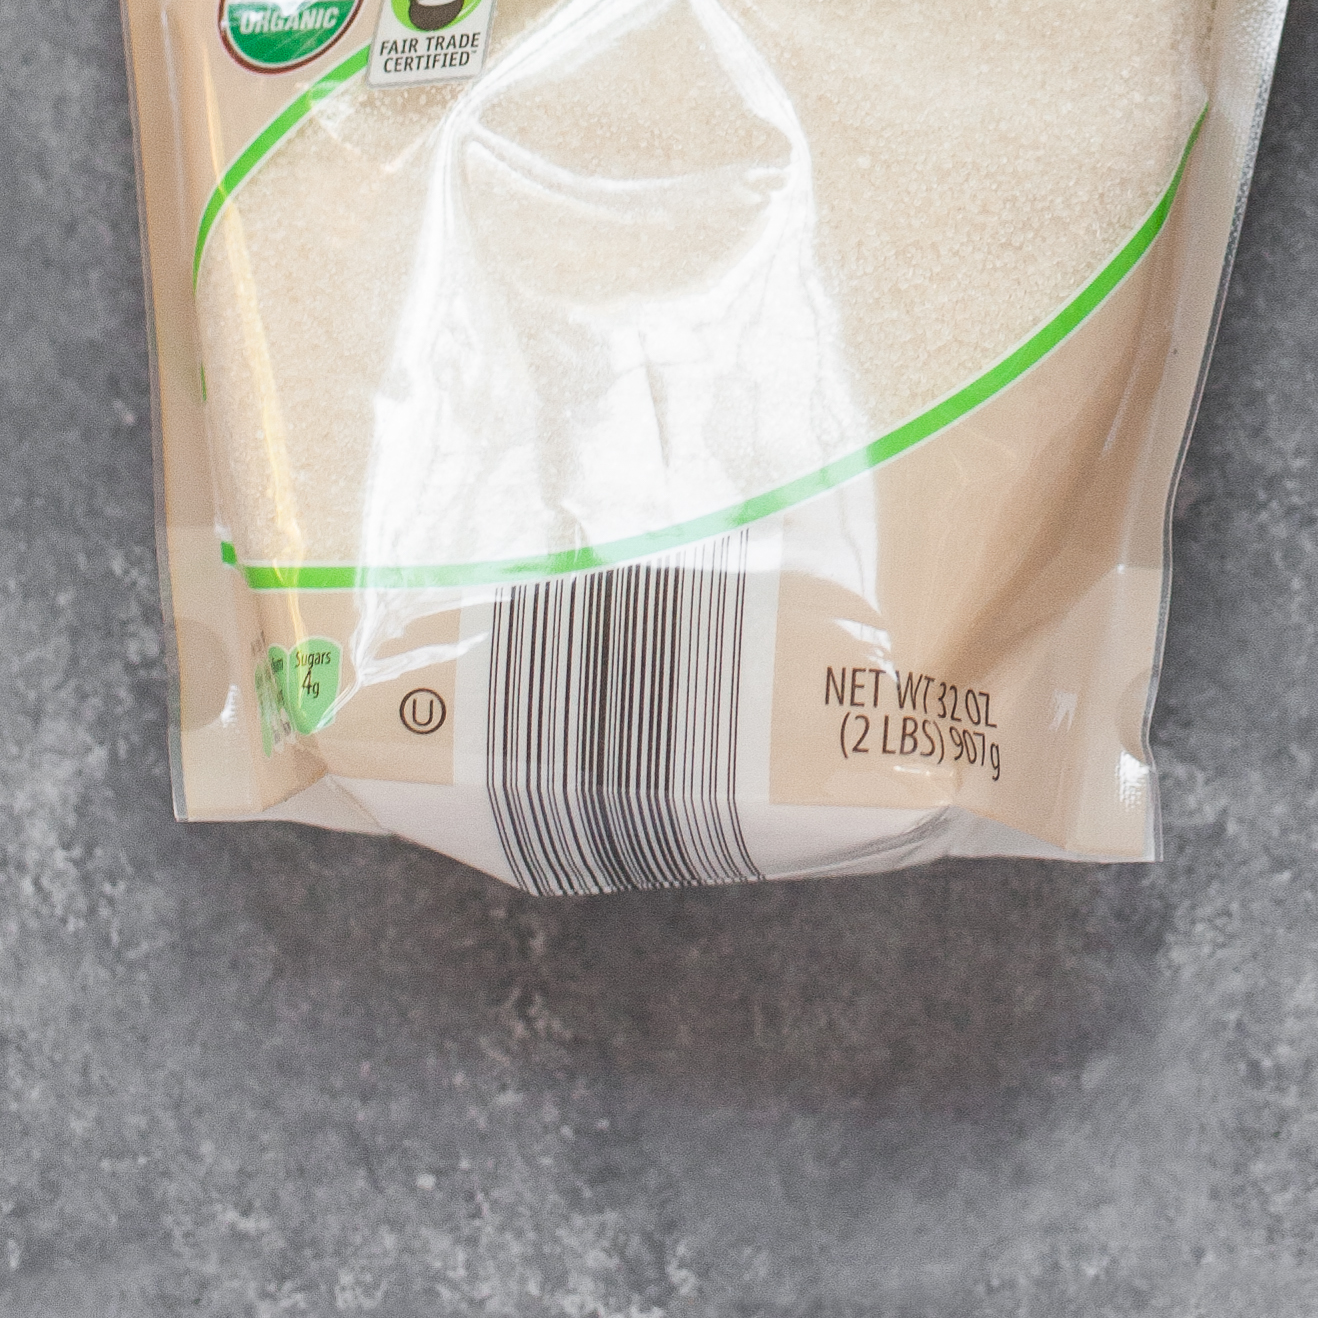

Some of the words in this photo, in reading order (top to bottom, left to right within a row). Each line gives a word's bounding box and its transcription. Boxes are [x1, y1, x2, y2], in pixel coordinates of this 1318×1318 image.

[240, 7, 339, 34] ORGANIC
[380, 39, 419, 56] FAIR
[426, 32, 480, 50] TRADE
[383, 51, 470, 73] CERTIFIED
[295, 650, 331, 669] Sugars
[302, 669, 319, 699] 4g
[825, 666, 886, 708] NET
[895, 670, 935, 714] WT
[938, 681, 962, 722] 32
[965, 689, 997, 728] OZ
[840, 711, 870, 759] (2
[882, 715, 945, 764] LBS)
[950, 726, 1000, 781] 907g
